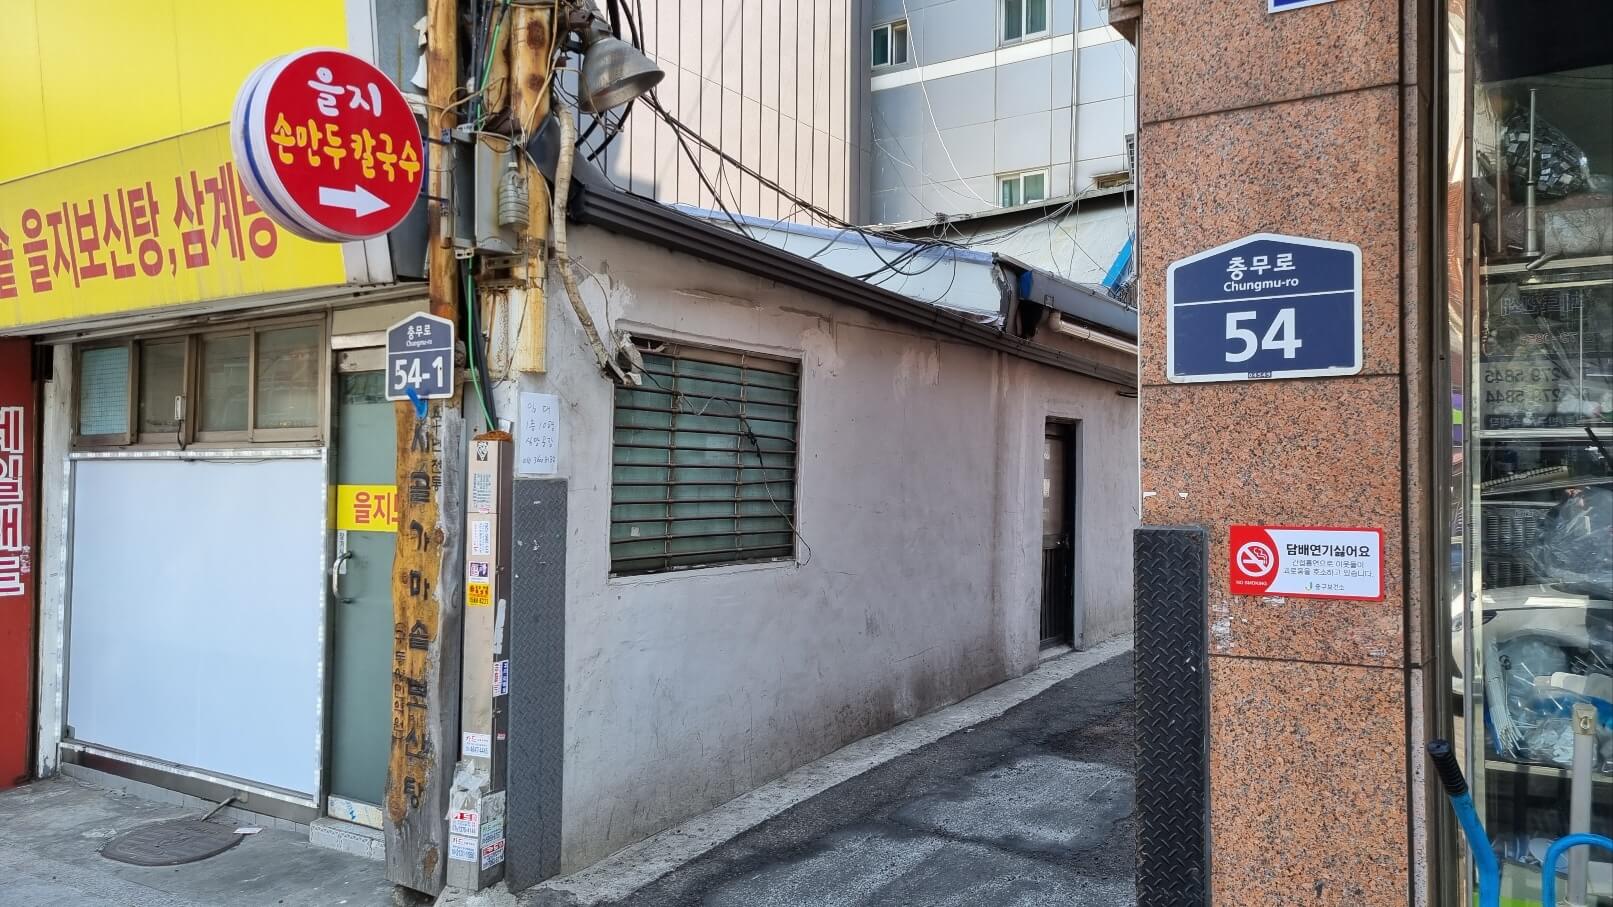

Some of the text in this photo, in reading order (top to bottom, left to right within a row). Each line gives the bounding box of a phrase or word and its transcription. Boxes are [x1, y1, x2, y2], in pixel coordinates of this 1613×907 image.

[307, 66, 382, 117] 을지
[270, 111, 421, 184] 손만두 칼국수
[1226, 253, 1297, 281] 충무로
[1223, 277, 1300, 293] Chungmu-ro
[407, 324, 432, 340] 충무로
[1224, 307, 1303, 363] 54
[393, 355, 444, 390] 54-1
[353, 490, 400, 526] 을지
[1286, 543, 1371, 558] 담배연기싫어요
